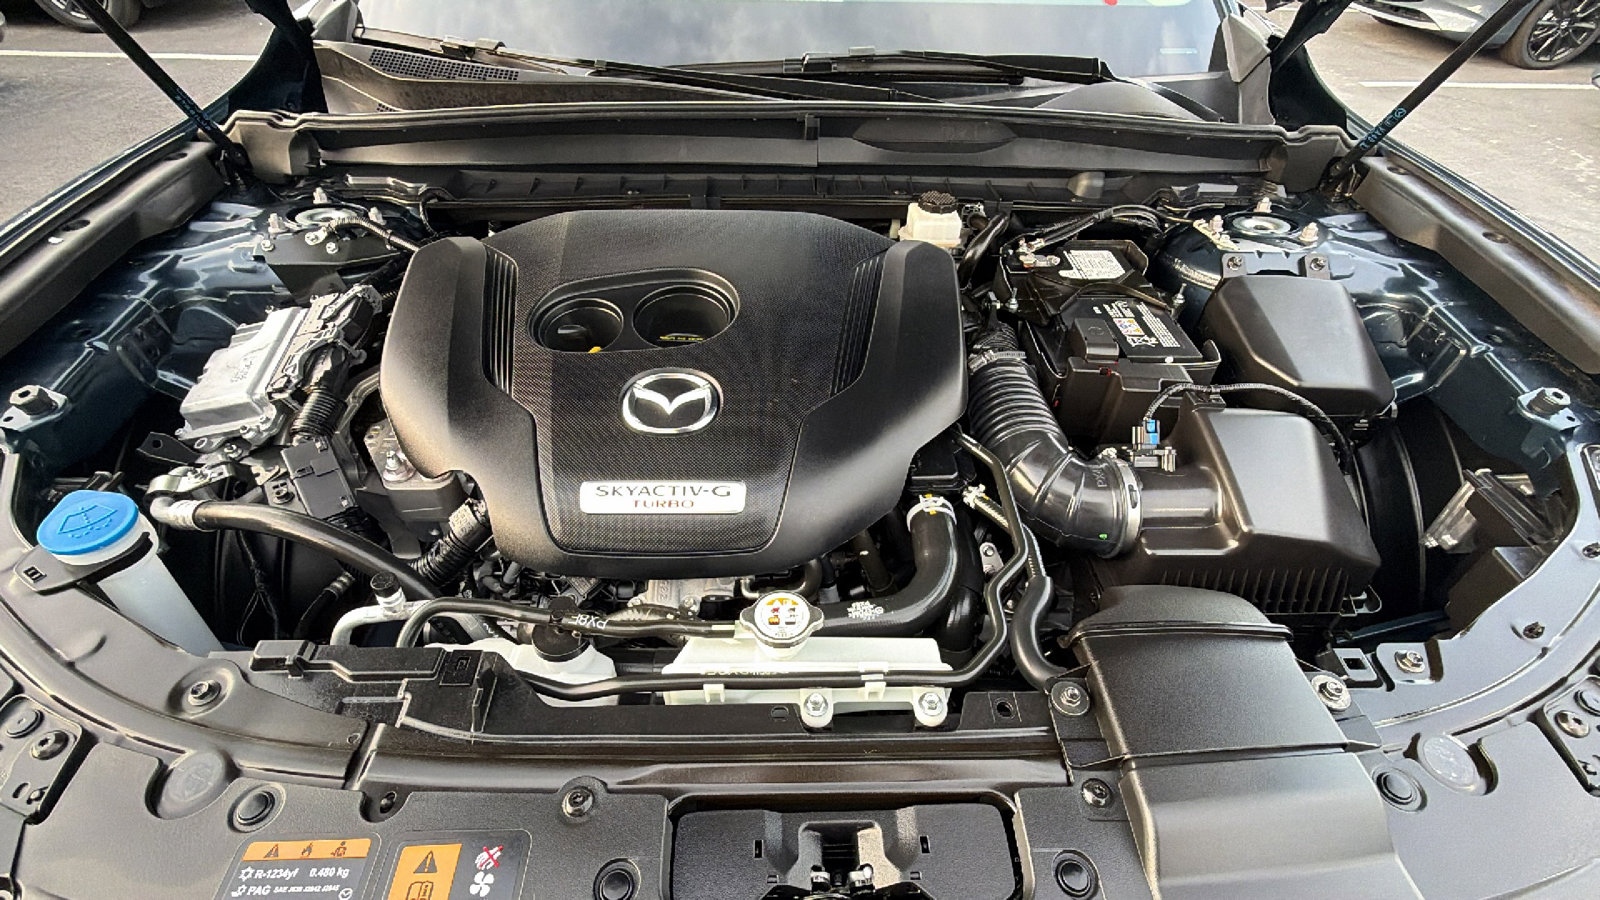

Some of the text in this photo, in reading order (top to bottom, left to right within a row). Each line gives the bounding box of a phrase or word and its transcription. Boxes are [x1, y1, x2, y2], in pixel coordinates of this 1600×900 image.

[595, 485, 731, 497] SKYACTIV-G
[634, 499, 695, 508] TURBO
[254, 866, 350, 881] R-1234yf 0.480 kg
[246, 884, 272, 896] PAG
